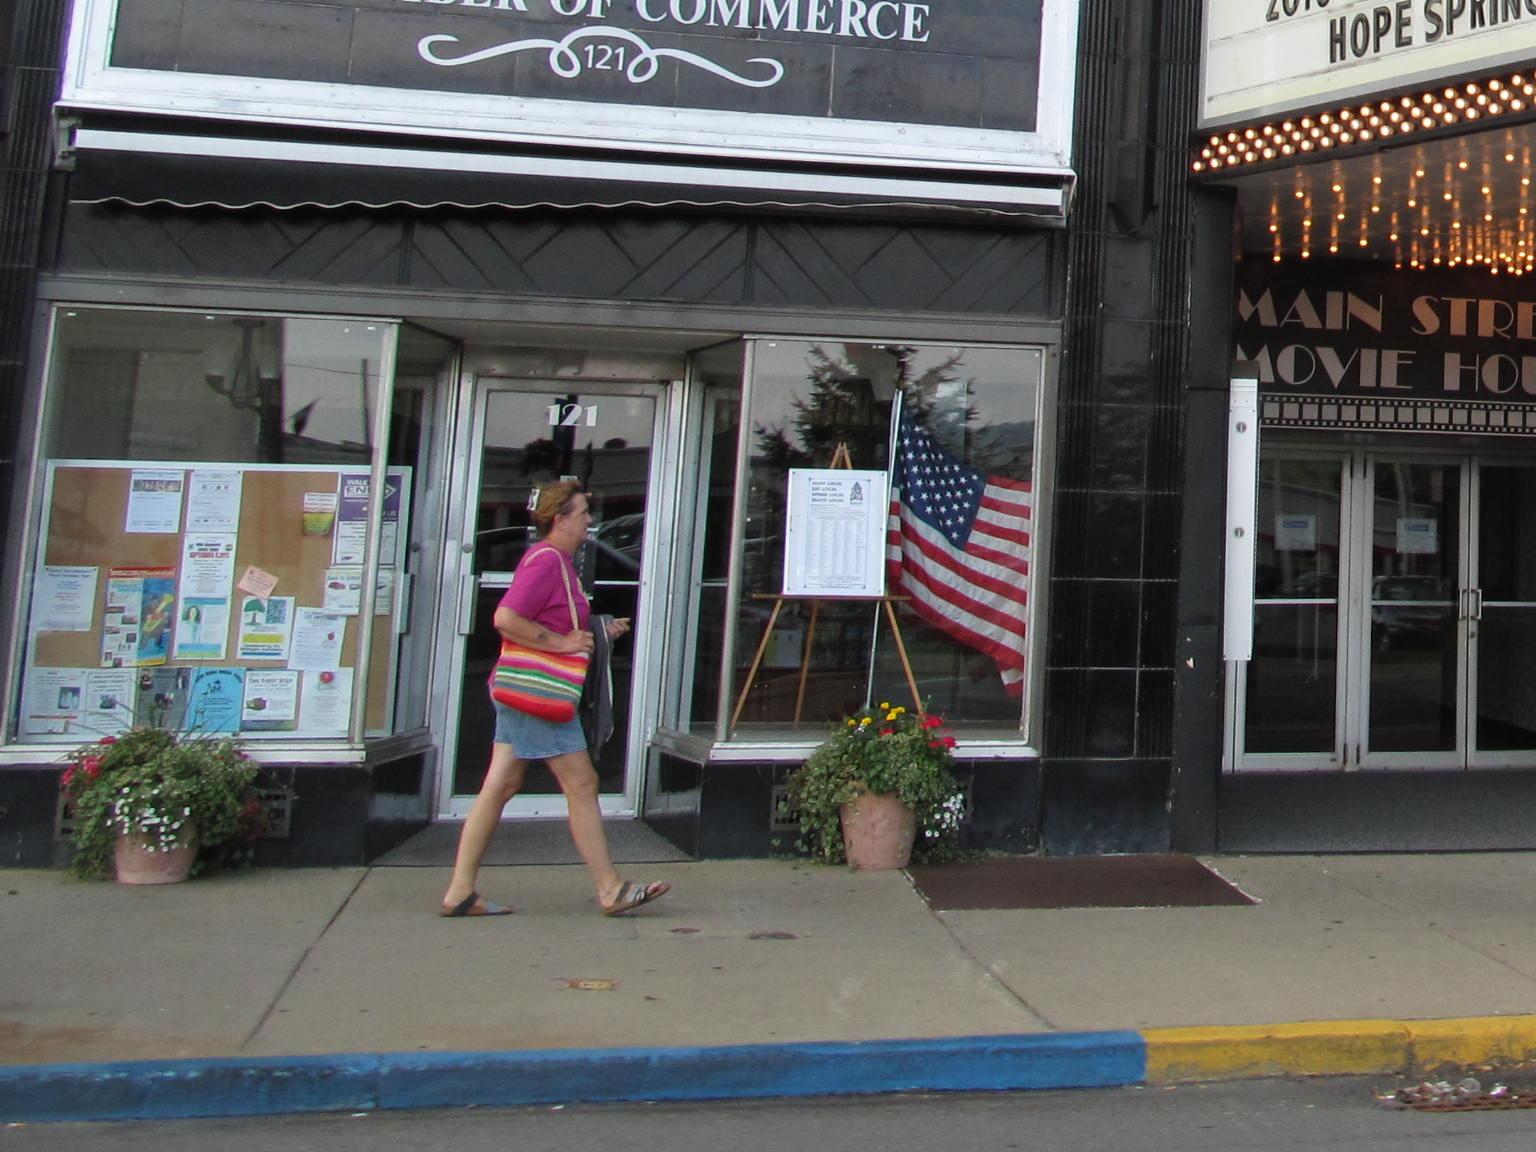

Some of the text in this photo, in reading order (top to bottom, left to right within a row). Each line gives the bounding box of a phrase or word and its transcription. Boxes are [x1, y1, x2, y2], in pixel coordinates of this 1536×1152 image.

[1329, 0, 1413, 64] HOPE
[583, 44, 626, 71] 121
[1237, 288, 1383, 333] MAIN
[1236, 343, 1417, 390] MOVIE
[546, 403, 598, 427] 121
